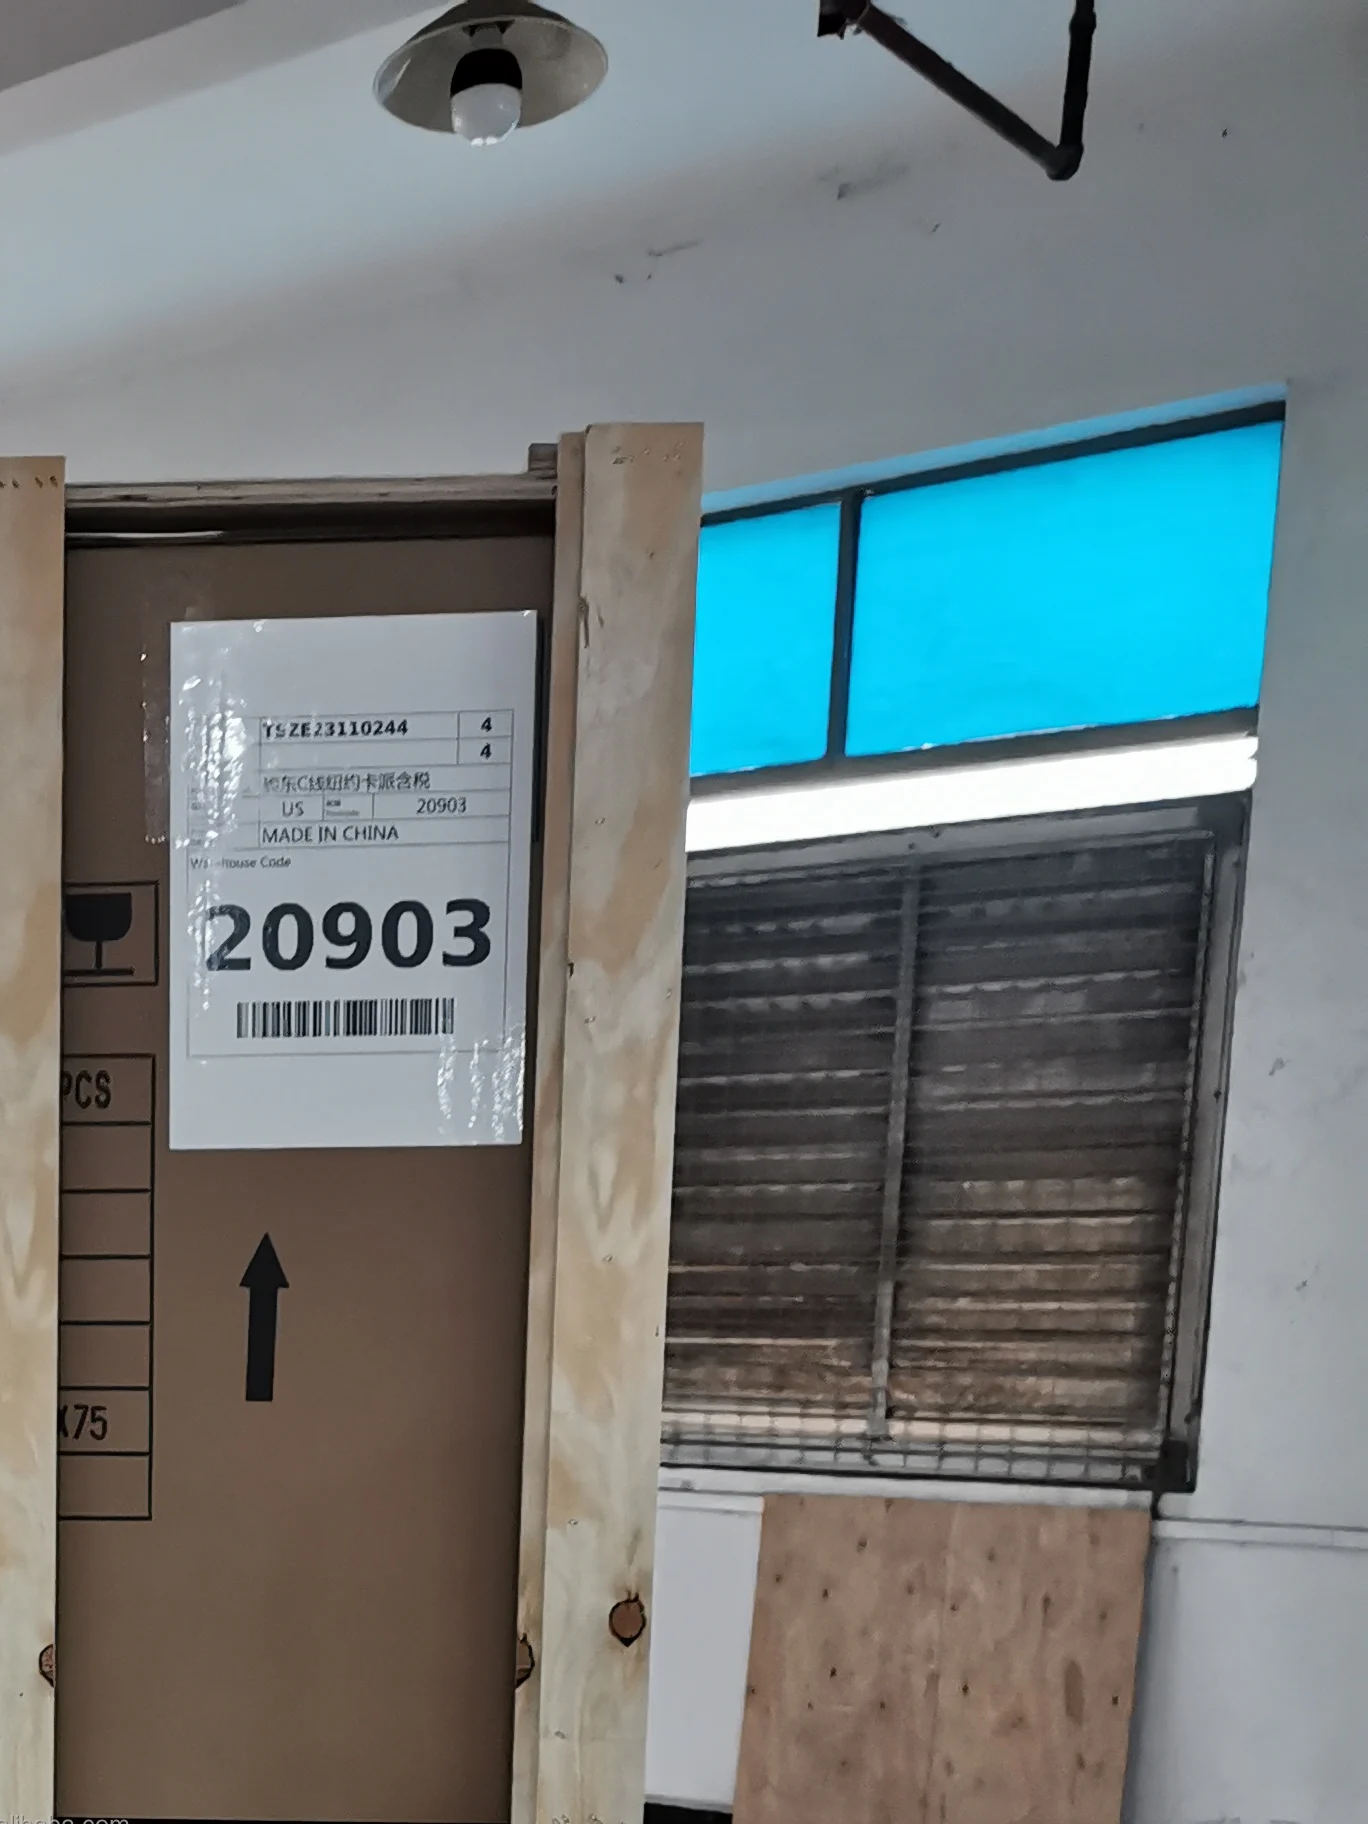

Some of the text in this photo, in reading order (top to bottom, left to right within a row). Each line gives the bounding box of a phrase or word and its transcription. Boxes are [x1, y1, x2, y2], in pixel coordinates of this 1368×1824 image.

[263, 719, 408, 739] TSZE23110244
[480, 717, 492, 732] 4
[479, 743, 492, 759] 4
[281, 800, 304, 818] US
[416, 796, 467, 814] 20903
[262, 824, 399, 843] MADE IN CHINA
[190, 855, 292, 870] Wahouse Code
[206, 898, 491, 971] 20903
